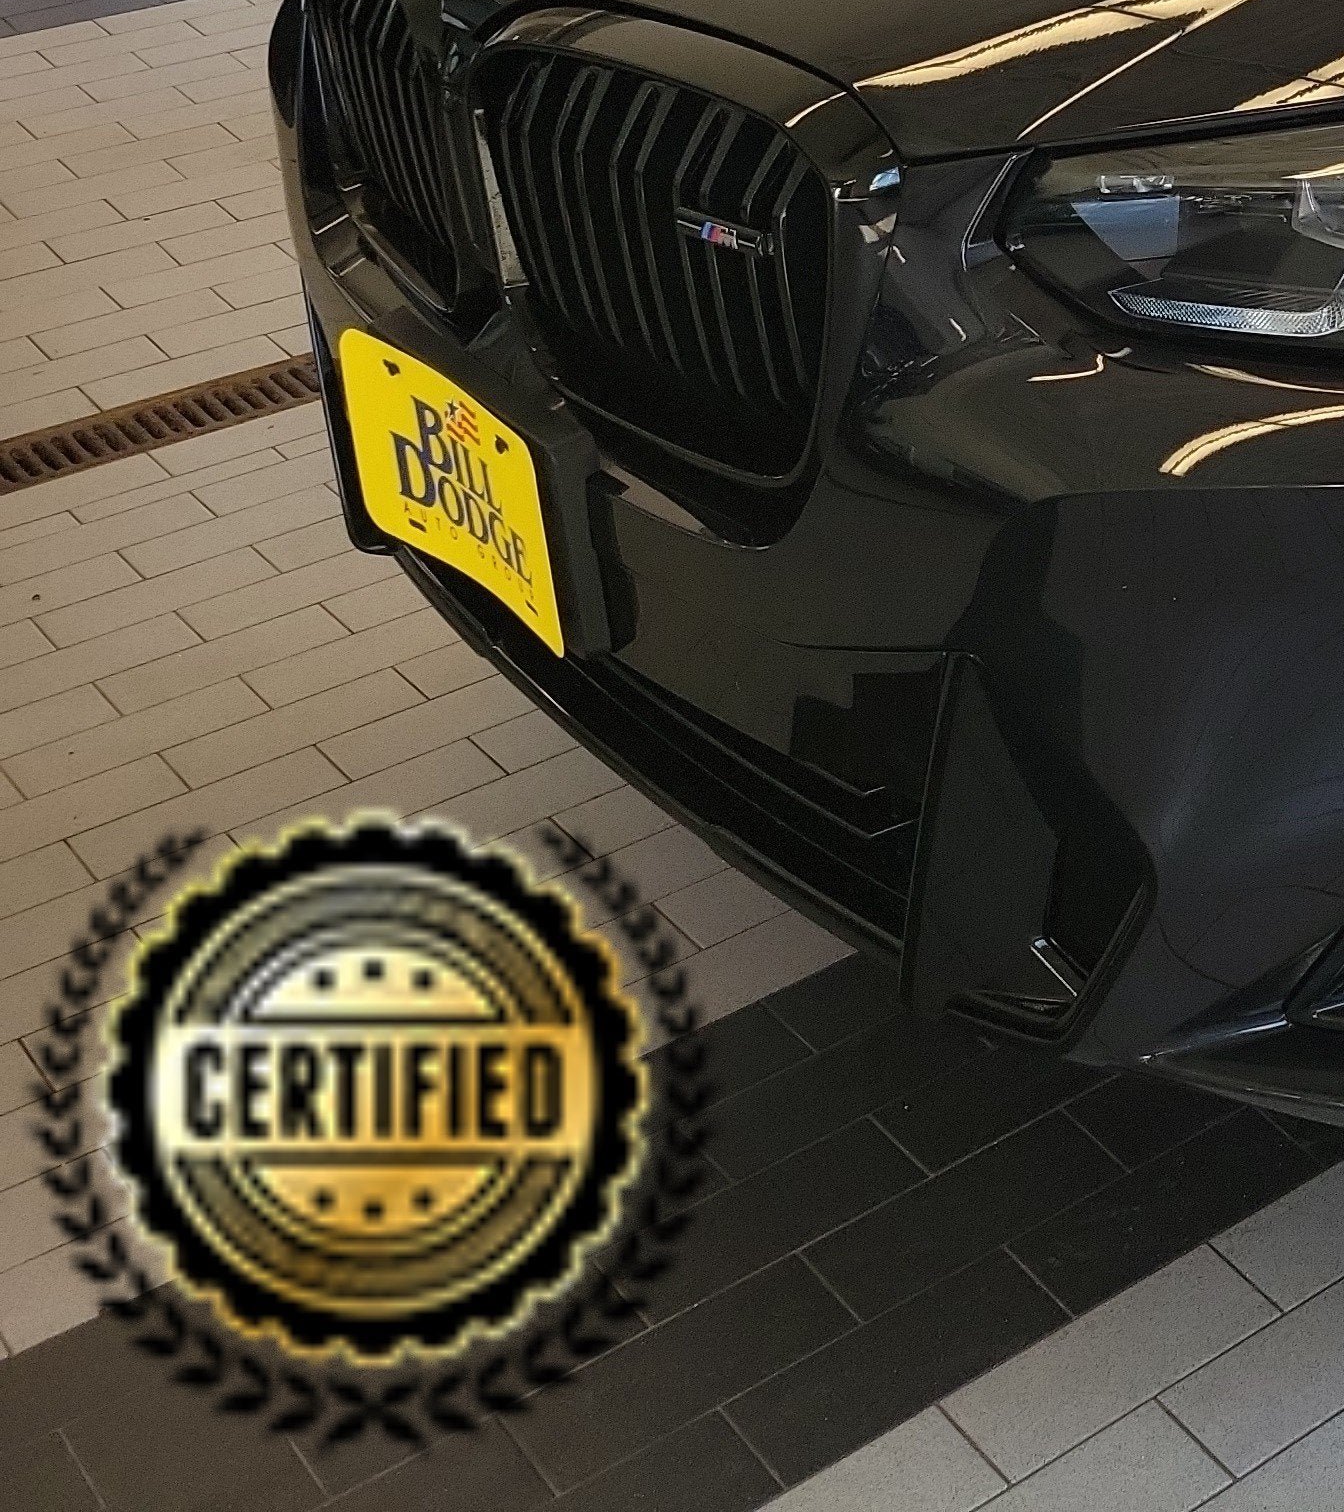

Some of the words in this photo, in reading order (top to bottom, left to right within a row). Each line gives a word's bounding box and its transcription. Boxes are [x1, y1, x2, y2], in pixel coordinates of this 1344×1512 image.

[390, 430, 533, 587] DODGE
[411, 395, 503, 515] BILL
[404, 501, 459, 541] AUTO
